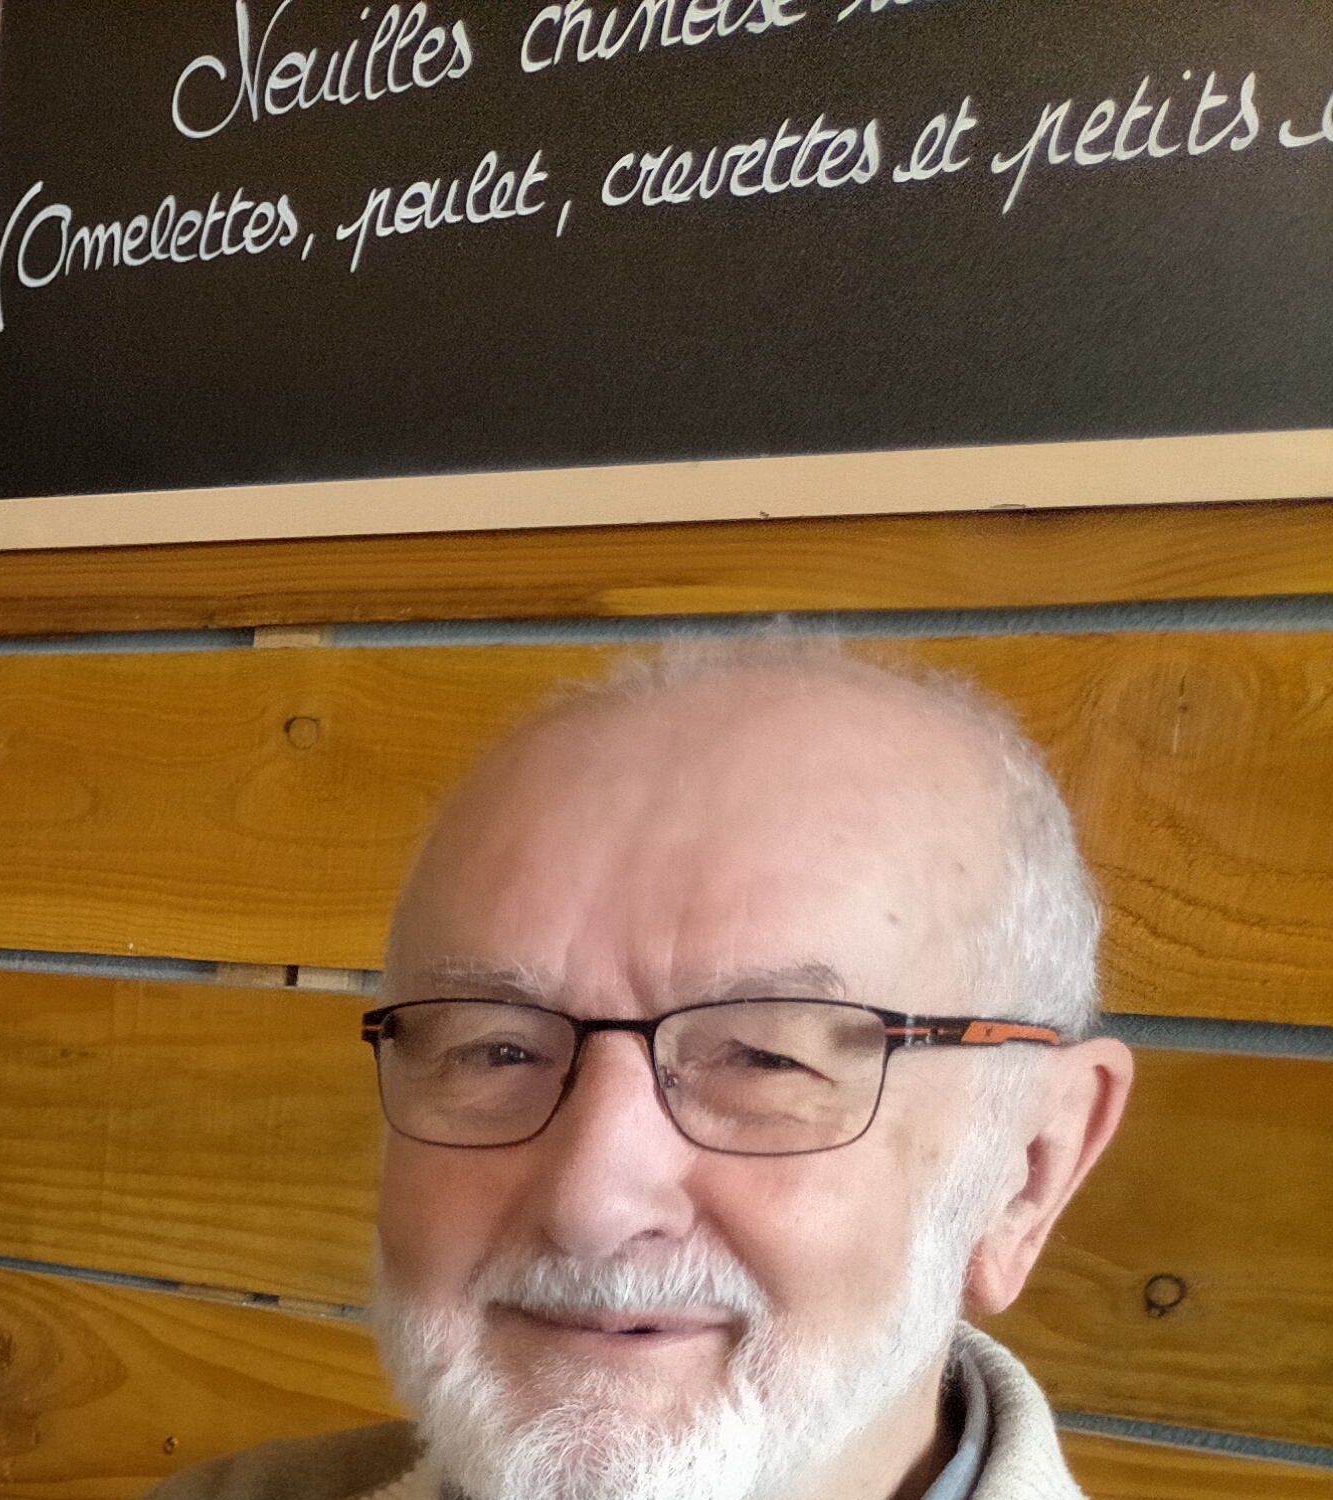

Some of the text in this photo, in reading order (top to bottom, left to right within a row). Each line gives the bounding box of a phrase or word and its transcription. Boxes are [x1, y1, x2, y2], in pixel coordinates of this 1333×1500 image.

[172, 0, 473, 138] Nouilles
[336, 150, 572, 273] poulet,
[601, 114, 880, 207] crevettes
[893, 96, 978, 184] et
[991, 70, 1260, 215] petits
